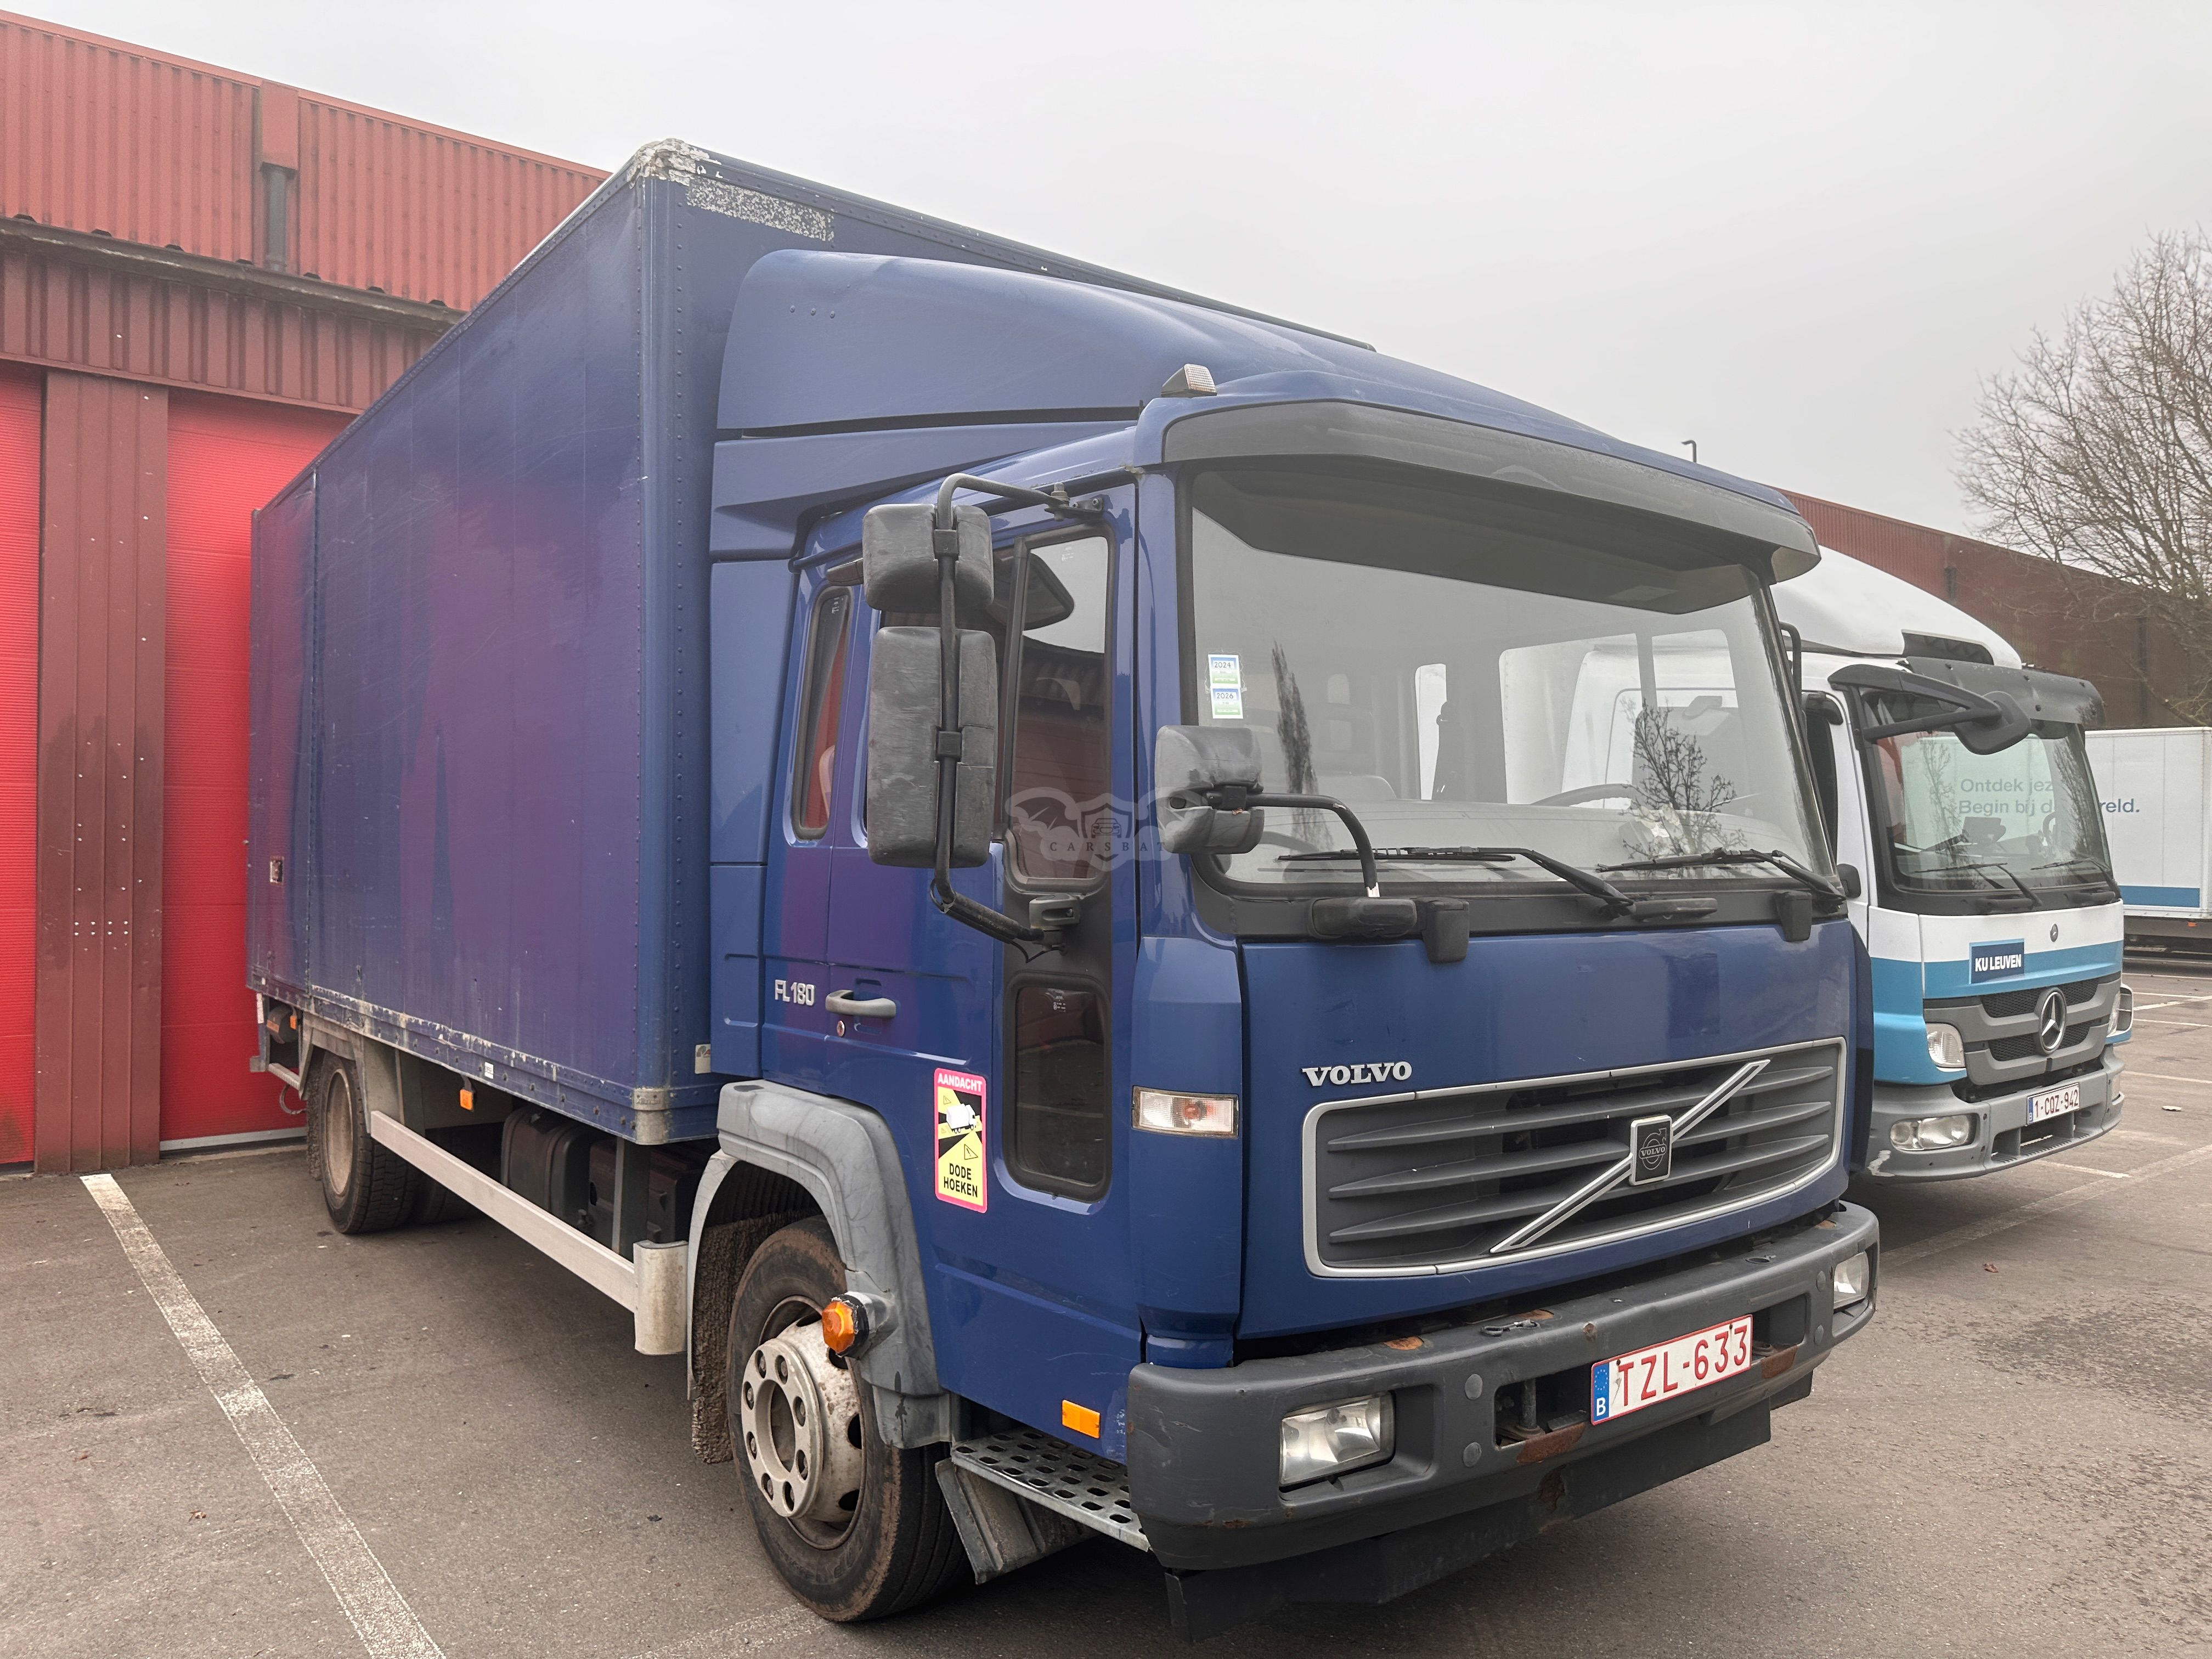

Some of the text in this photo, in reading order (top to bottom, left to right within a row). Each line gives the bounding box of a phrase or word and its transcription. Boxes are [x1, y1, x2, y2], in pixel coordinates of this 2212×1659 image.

[1961, 778, 2053, 796] Ontdek jez
[1959, 799, 2140, 817] Begin bij d reld.
[1975, 953, 2022, 972] KU LEUVEN
[938, 1073, 983, 1092] AANDACHT
[1301, 1060, 1413, 1087] VOLVO
[1640, 1146, 1666, 1156] VOLVO
[949, 1163, 972, 1181] DODE
[944, 1176, 978, 1198] HOEKEN
[1618, 1325, 1748, 1407] TZL-633
[1596, 1397, 1606, 1417] B
